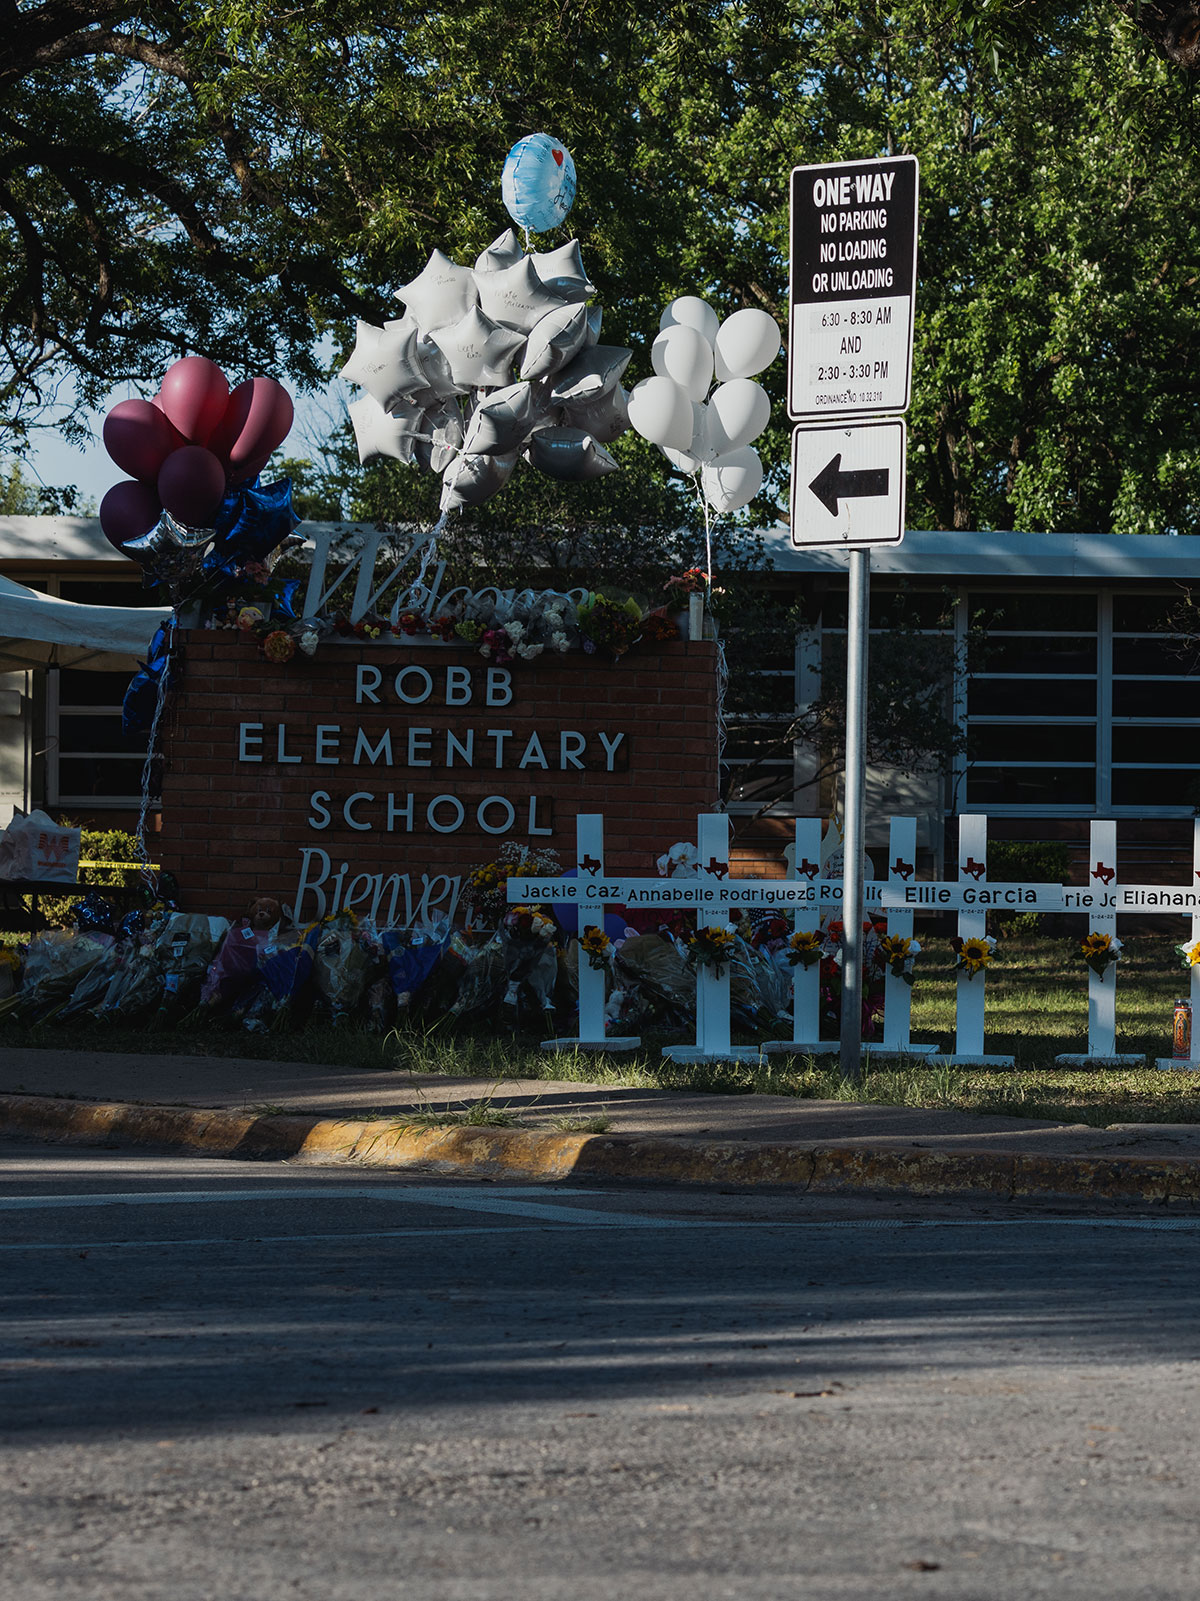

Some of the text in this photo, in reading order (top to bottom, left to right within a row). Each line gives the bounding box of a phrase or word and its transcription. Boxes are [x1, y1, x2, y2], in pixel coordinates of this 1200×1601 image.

[813, 172, 896, 208] ONE WAY
[820, 208, 887, 233] NO PARKING
[820, 238, 887, 262] NO LOADING
[812, 267, 894, 293] OR UNLOADING
[821, 312, 840, 326] 6:30
[850, 310, 872, 325] 8:30
[876, 306, 892, 324] AM
[840, 336, 862, 354] AND
[818, 366, 840, 380] 2:30
[849, 364, 871, 378] 3:30
[874, 361, 889, 379] PM
[815, 394, 848, 405] ORDINANCE
[355, 664, 515, 708] ROBB
[238, 722, 626, 772] ELEMENTARY
[307, 790, 554, 837] SCHOOL
[521, 884, 624, 898] Jackie Caz
[627, 888, 806, 903] Annabelle Rodriguez
[905, 887, 1038, 904] Ellie Garcia
